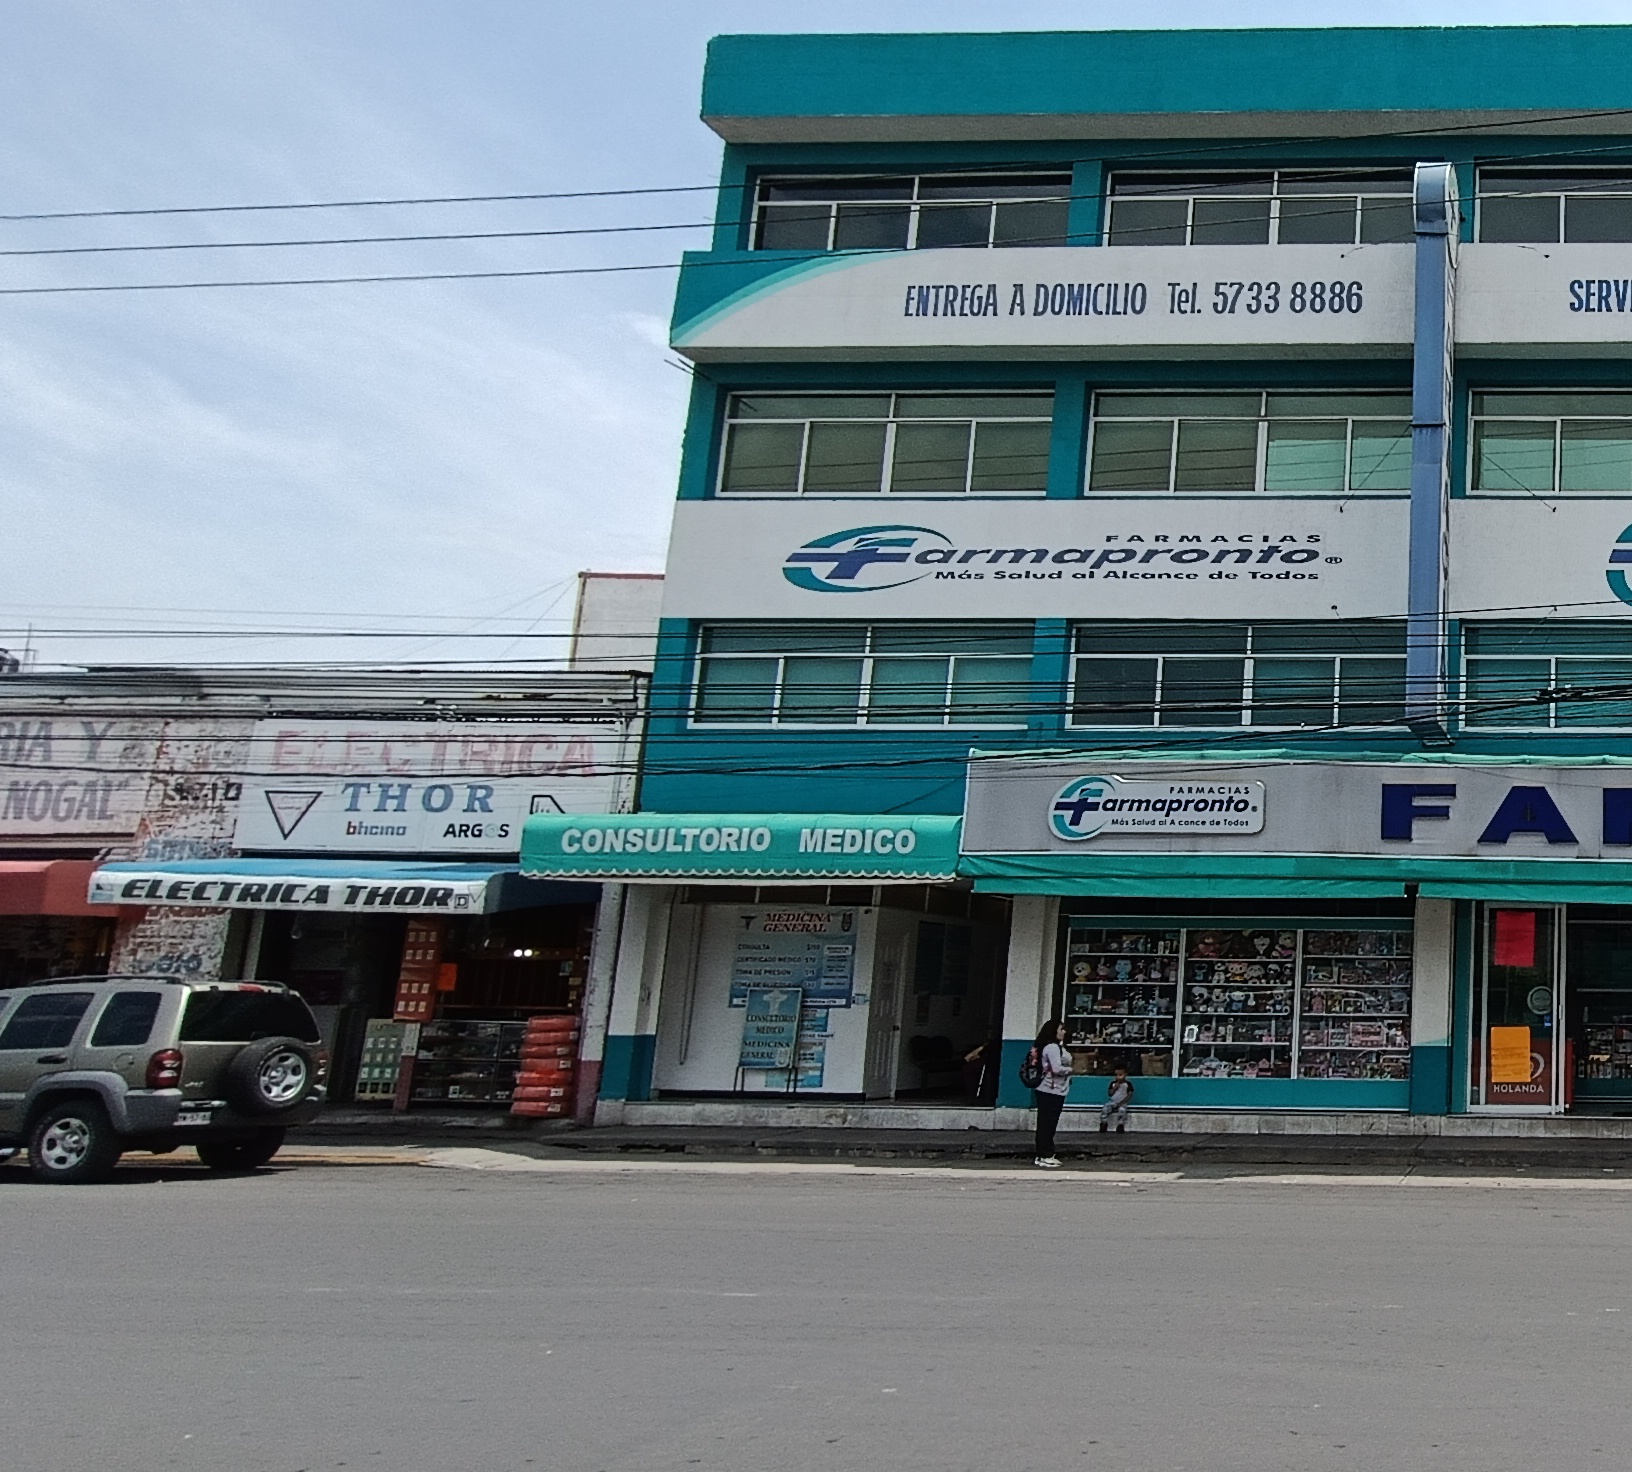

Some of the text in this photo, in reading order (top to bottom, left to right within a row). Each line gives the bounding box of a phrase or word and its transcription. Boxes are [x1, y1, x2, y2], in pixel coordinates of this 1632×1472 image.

[904, 281, 1364, 317] ENTREGA A DOMICILIO Tel. 5733 8886
[1105, 534, 1322, 543] FARMACIAS
[934, 569, 1319, 580] Más Salud al Alcance de Todos
[1169, 786, 1251, 795] FARMACIAS
[341, 782, 495, 813] THOR
[1131, 818, 1156, 826] Salud
[1158, 818, 1167, 826] al
[1209, 818, 1221, 826] de
[1223, 818, 1250, 826] Todos
[560, 827, 917, 854] CONSULTORIO MEDICO
[121, 878, 454, 907] ELECTRICA THOR
[765, 912, 832, 923] MEDICINA
[763, 922, 827, 933] GENERAL
[1493, 1084, 1545, 1094] HOLANDA
